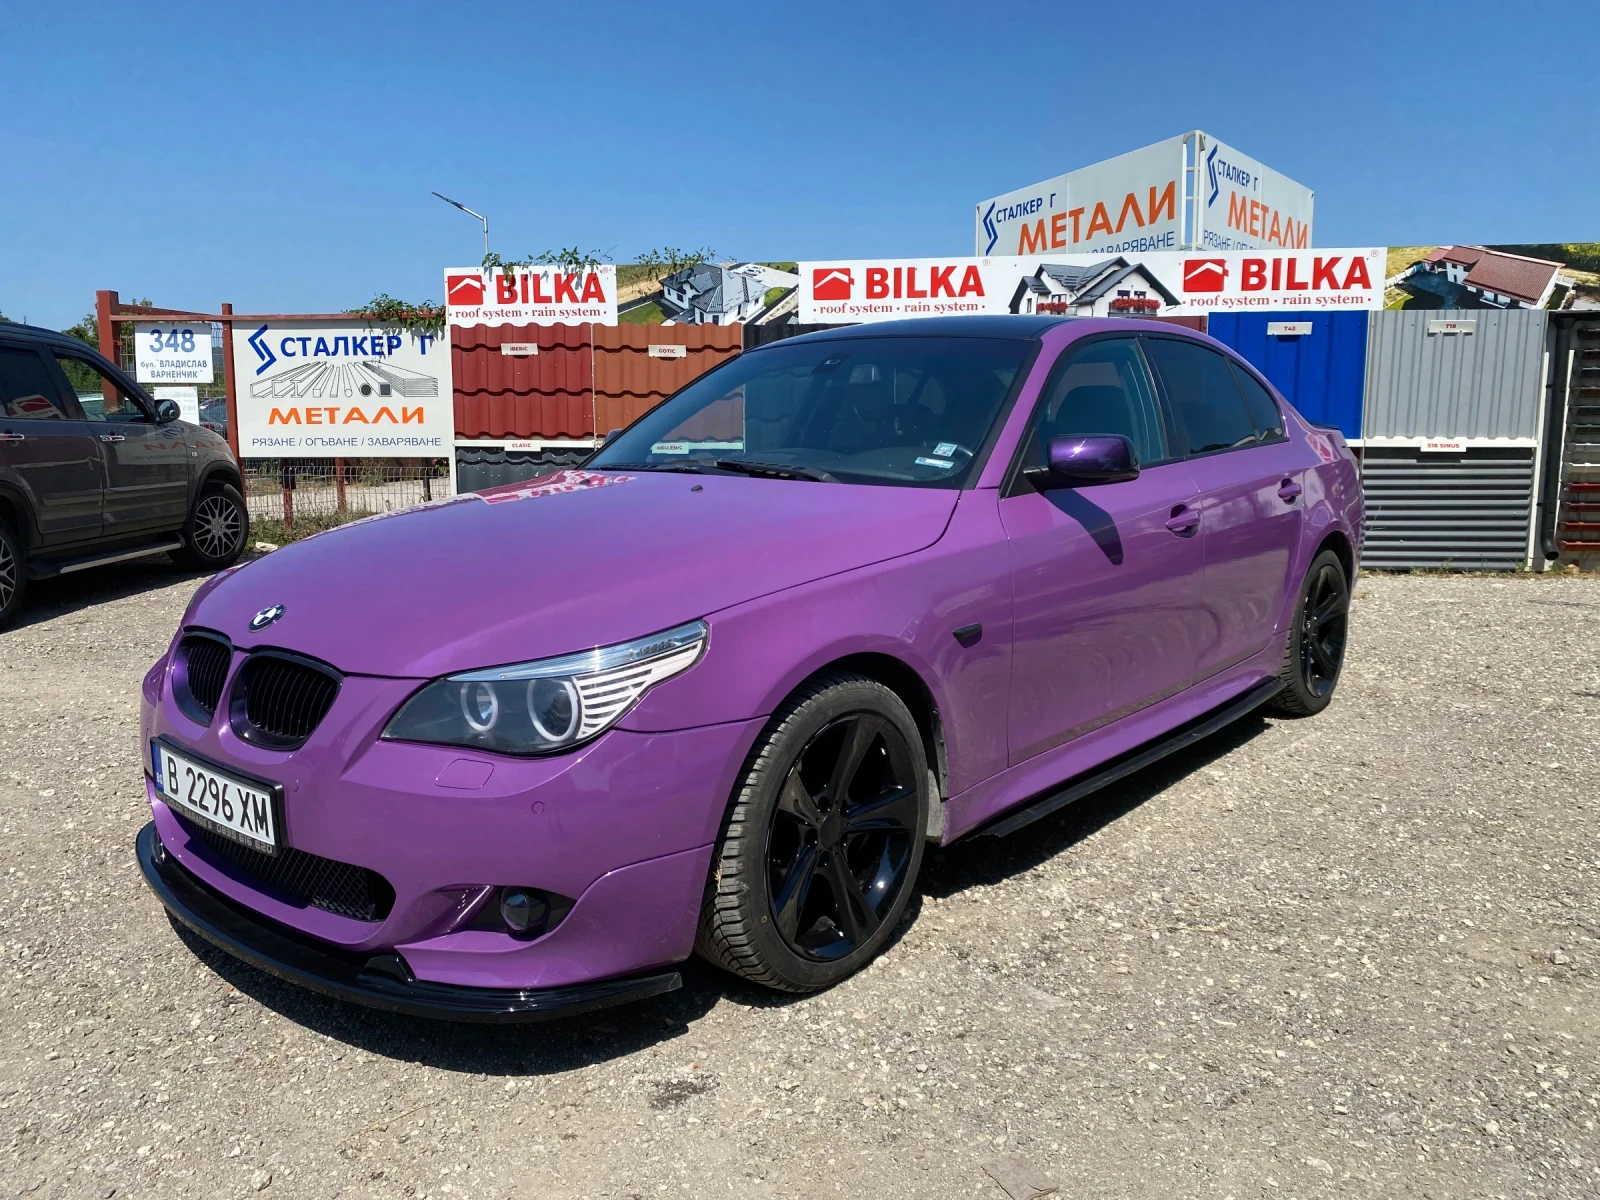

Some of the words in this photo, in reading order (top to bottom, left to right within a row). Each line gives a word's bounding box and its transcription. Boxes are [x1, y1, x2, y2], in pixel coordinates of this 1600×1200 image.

[1217, 159, 1251, 188] СТАЛКЕР
[1253, 177, 1259, 192] Г
[995, 198, 1043, 224] СТАЛКЕР
[1050, 193, 1057, 208] Г
[1017, 181, 1176, 256] МЕТАЛИ
[1227, 190, 1308, 250] МЕТАЛИ
[496, 272, 606, 304] BILKA
[866, 265, 985, 299] BILKA
[1241, 256, 1372, 291] BILKA
[455, 308, 481, 318] roof
[482, 308, 522, 320] system
[531, 307, 556, 317] rain
[559, 307, 601, 319] system
[820, 303, 848, 314] roof
[849, 303, 893, 316] system
[904, 302, 930, 313] rain
[934, 303, 979, 315] system
[1190, 295, 1221, 307] roof
[1222, 296, 1270, 309] system
[1282, 294, 1312, 306] rain
[1315, 294, 1364, 308] system
[149, 328, 196, 353] 348
[280, 336, 402, 357] СТАЛКЕР
[420, 335, 434, 355] Г
[268, 406, 425, 425] МЕТАЛИ
[252, 438, 296, 447] РЯЗАНЕ
[305, 437, 358, 447] ОГЪВАНЕ
[367, 437, 442, 446] ЗАВАРЯВАНЕ
[167, 755, 179, 795] B
[186, 766, 234, 822] 2296
[237, 787, 271, 839] XM
[216, 825, 237, 840] 0895
[239, 835, 252, 847] 616
[254, 841, 273, 854] 620
